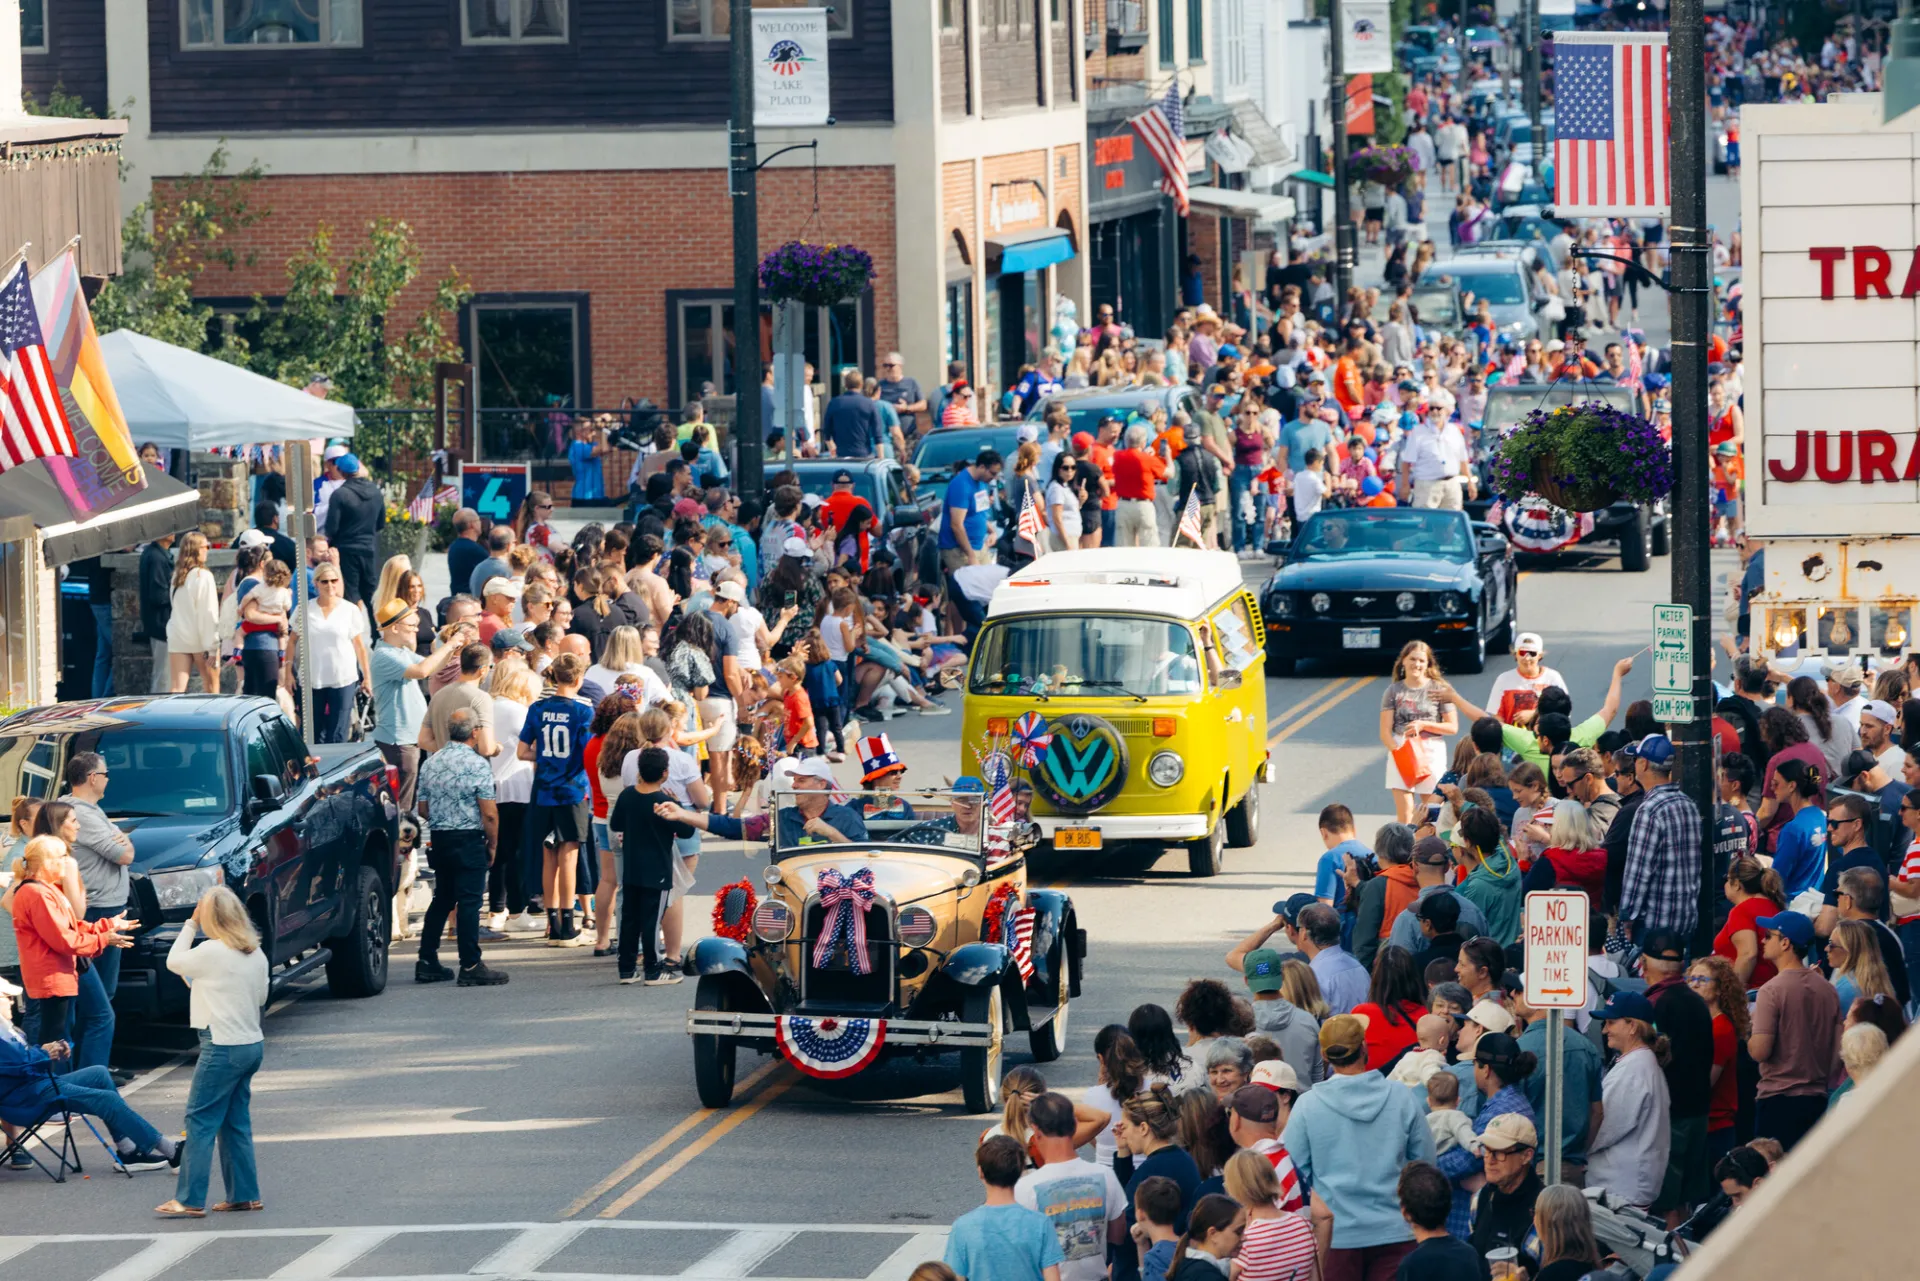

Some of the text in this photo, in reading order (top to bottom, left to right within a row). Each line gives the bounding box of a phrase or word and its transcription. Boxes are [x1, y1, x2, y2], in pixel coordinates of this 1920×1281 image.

[757, 22, 819, 33] WELCOME
[773, 80, 803, 90] LAKE
[770, 95, 812, 105] PLACID
[478, 477, 511, 519] 4
[1660, 610, 1684, 622] METER
[1657, 627, 1687, 640] PARKING
[1654, 650, 1690, 663] PAY HERE
[1654, 699, 1692, 717] 8AM-8PM
[541, 723, 570, 759] 10
[1077, 832, 1092, 845] BUS
[1546, 900, 1568, 922] NO
[1530, 925, 1583, 947] PARKING
[1545, 950, 1568, 964] ANY
[1543, 967, 1570, 982] TIME
